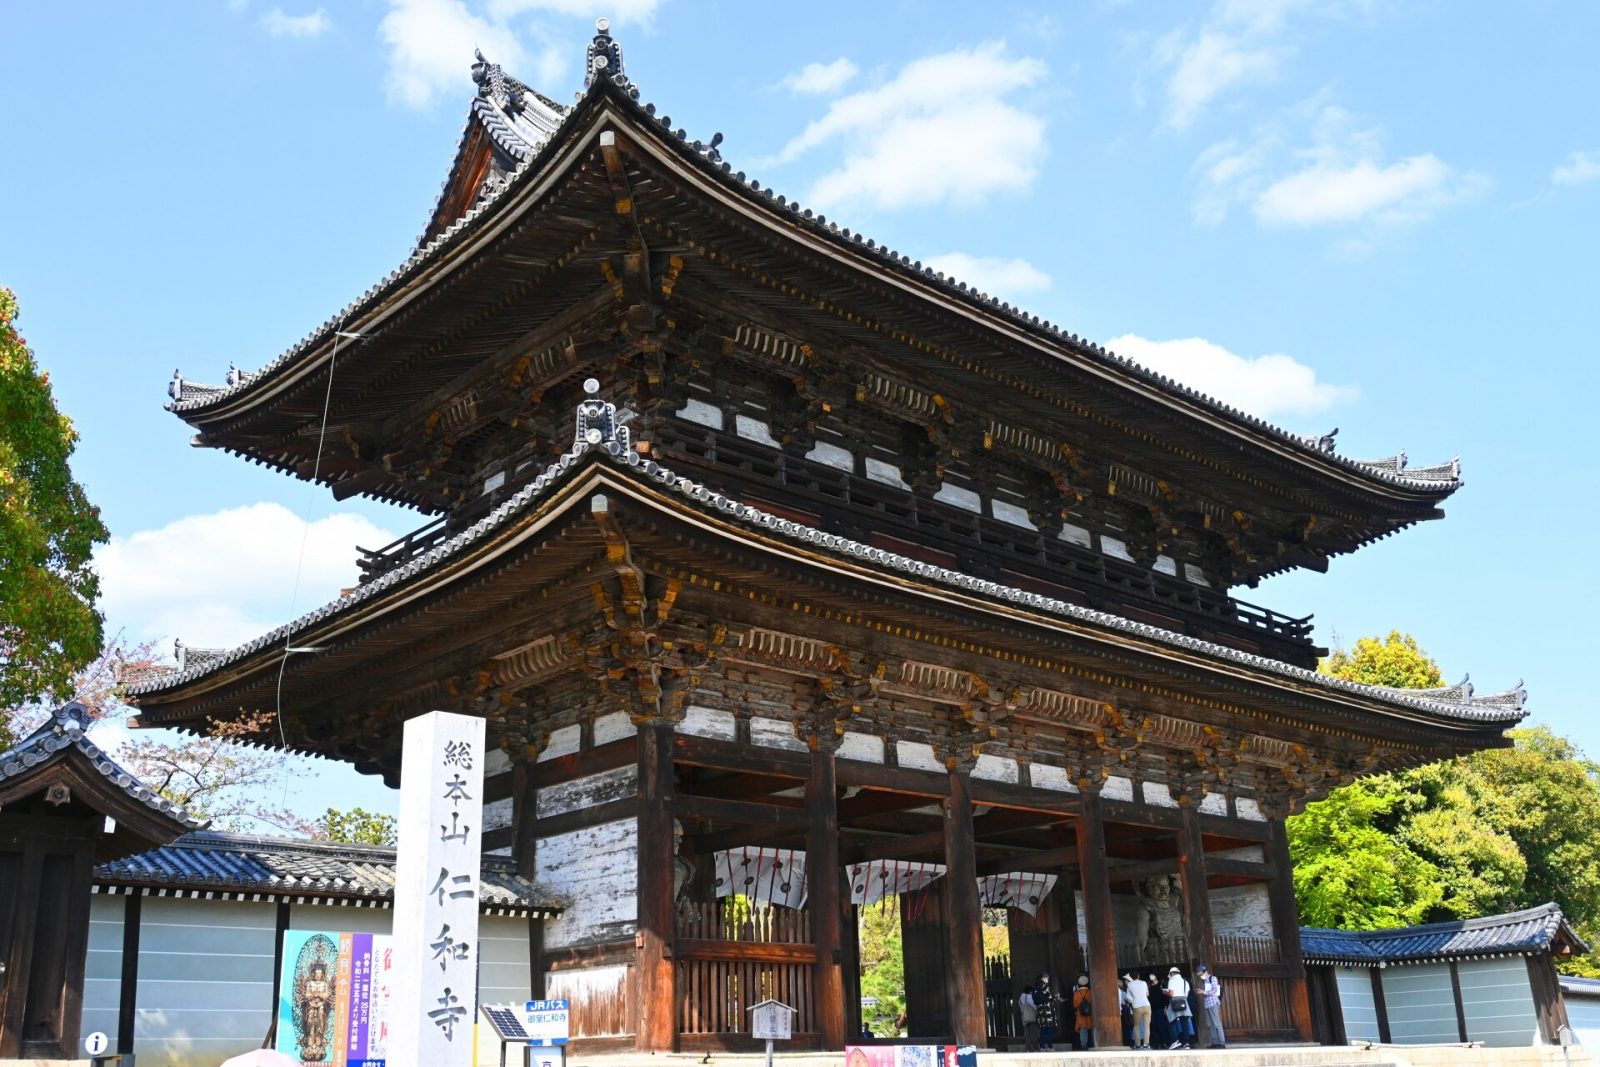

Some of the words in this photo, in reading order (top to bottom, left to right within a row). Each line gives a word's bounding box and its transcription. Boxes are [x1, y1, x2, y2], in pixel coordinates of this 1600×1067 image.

[427, 739, 475, 1043] 総本山仁和寺
[530, 1001, 564, 1011] JRバス
